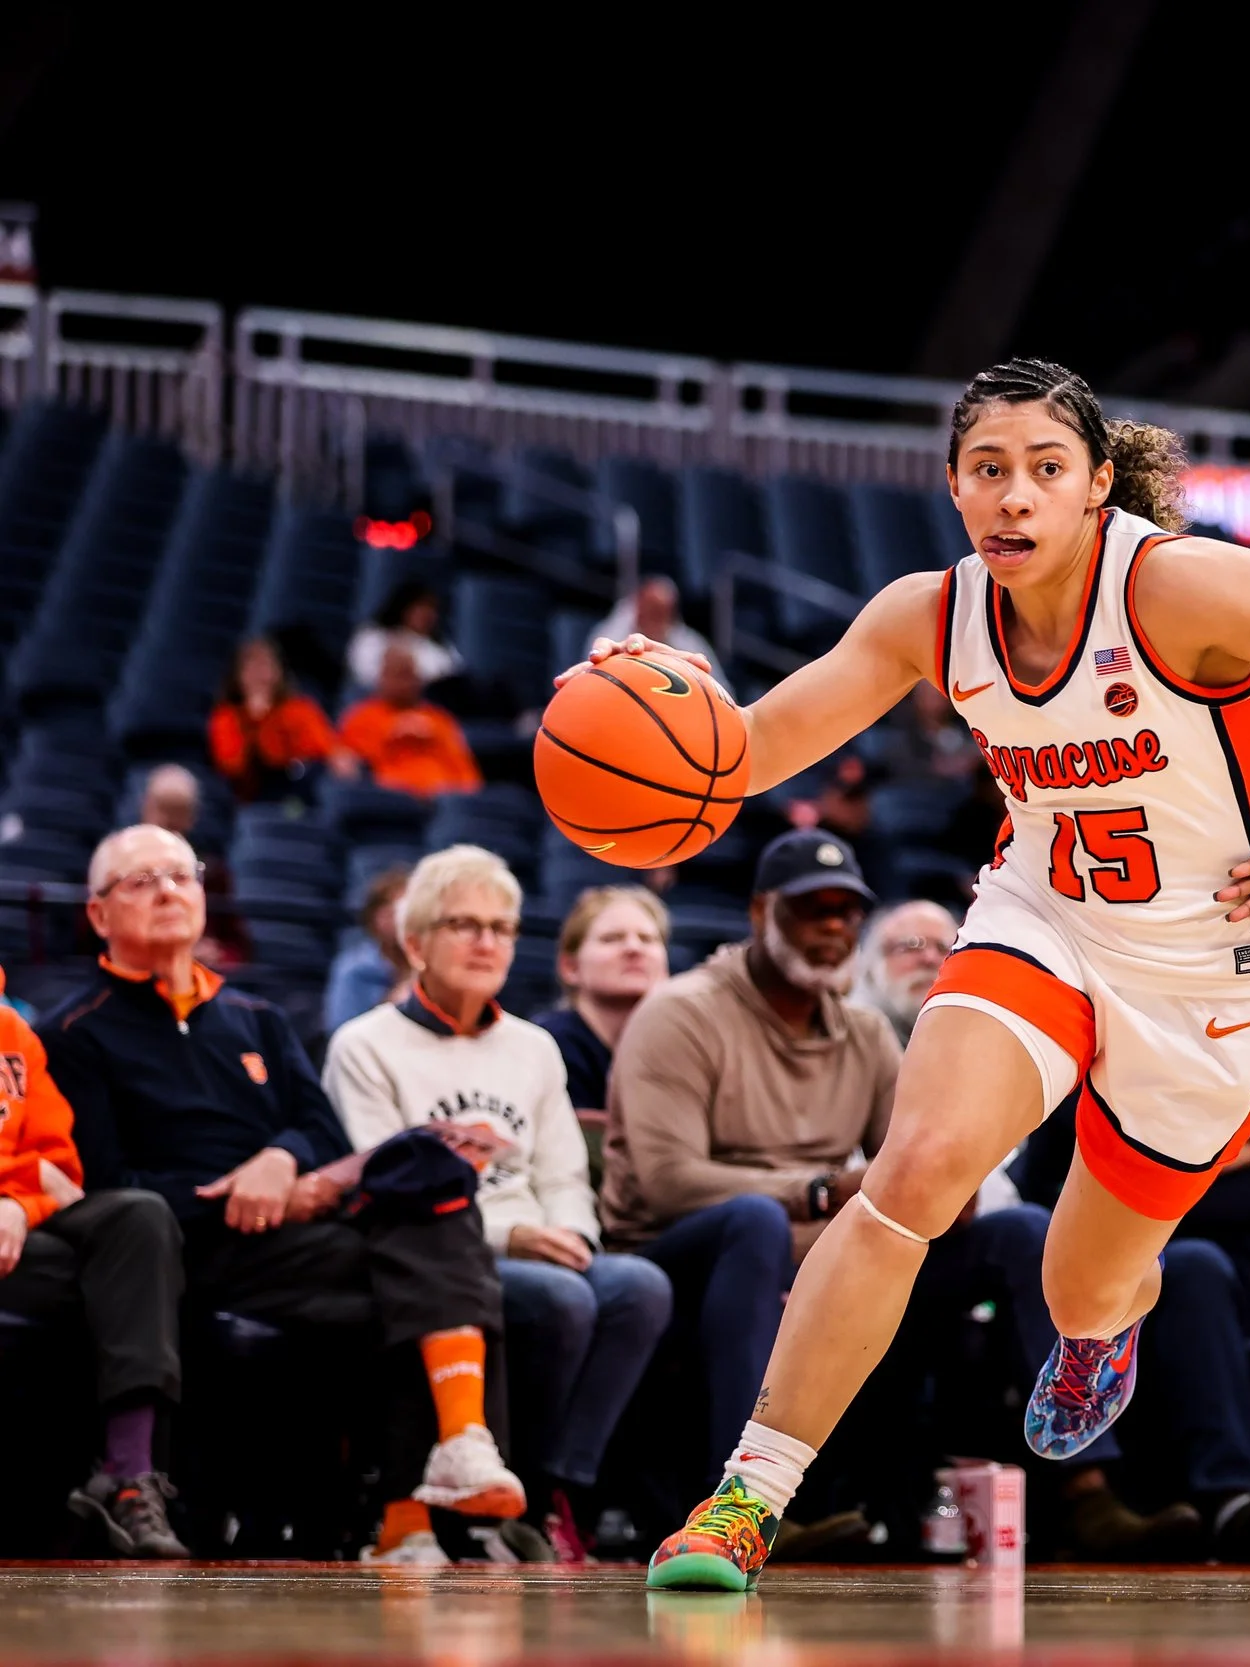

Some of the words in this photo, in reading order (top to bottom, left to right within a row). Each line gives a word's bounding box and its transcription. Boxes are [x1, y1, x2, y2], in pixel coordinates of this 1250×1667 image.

[1110, 690, 1135, 705] ACC
[971, 728, 1169, 803] Syracuse
[1048, 806, 1162, 904] 15
